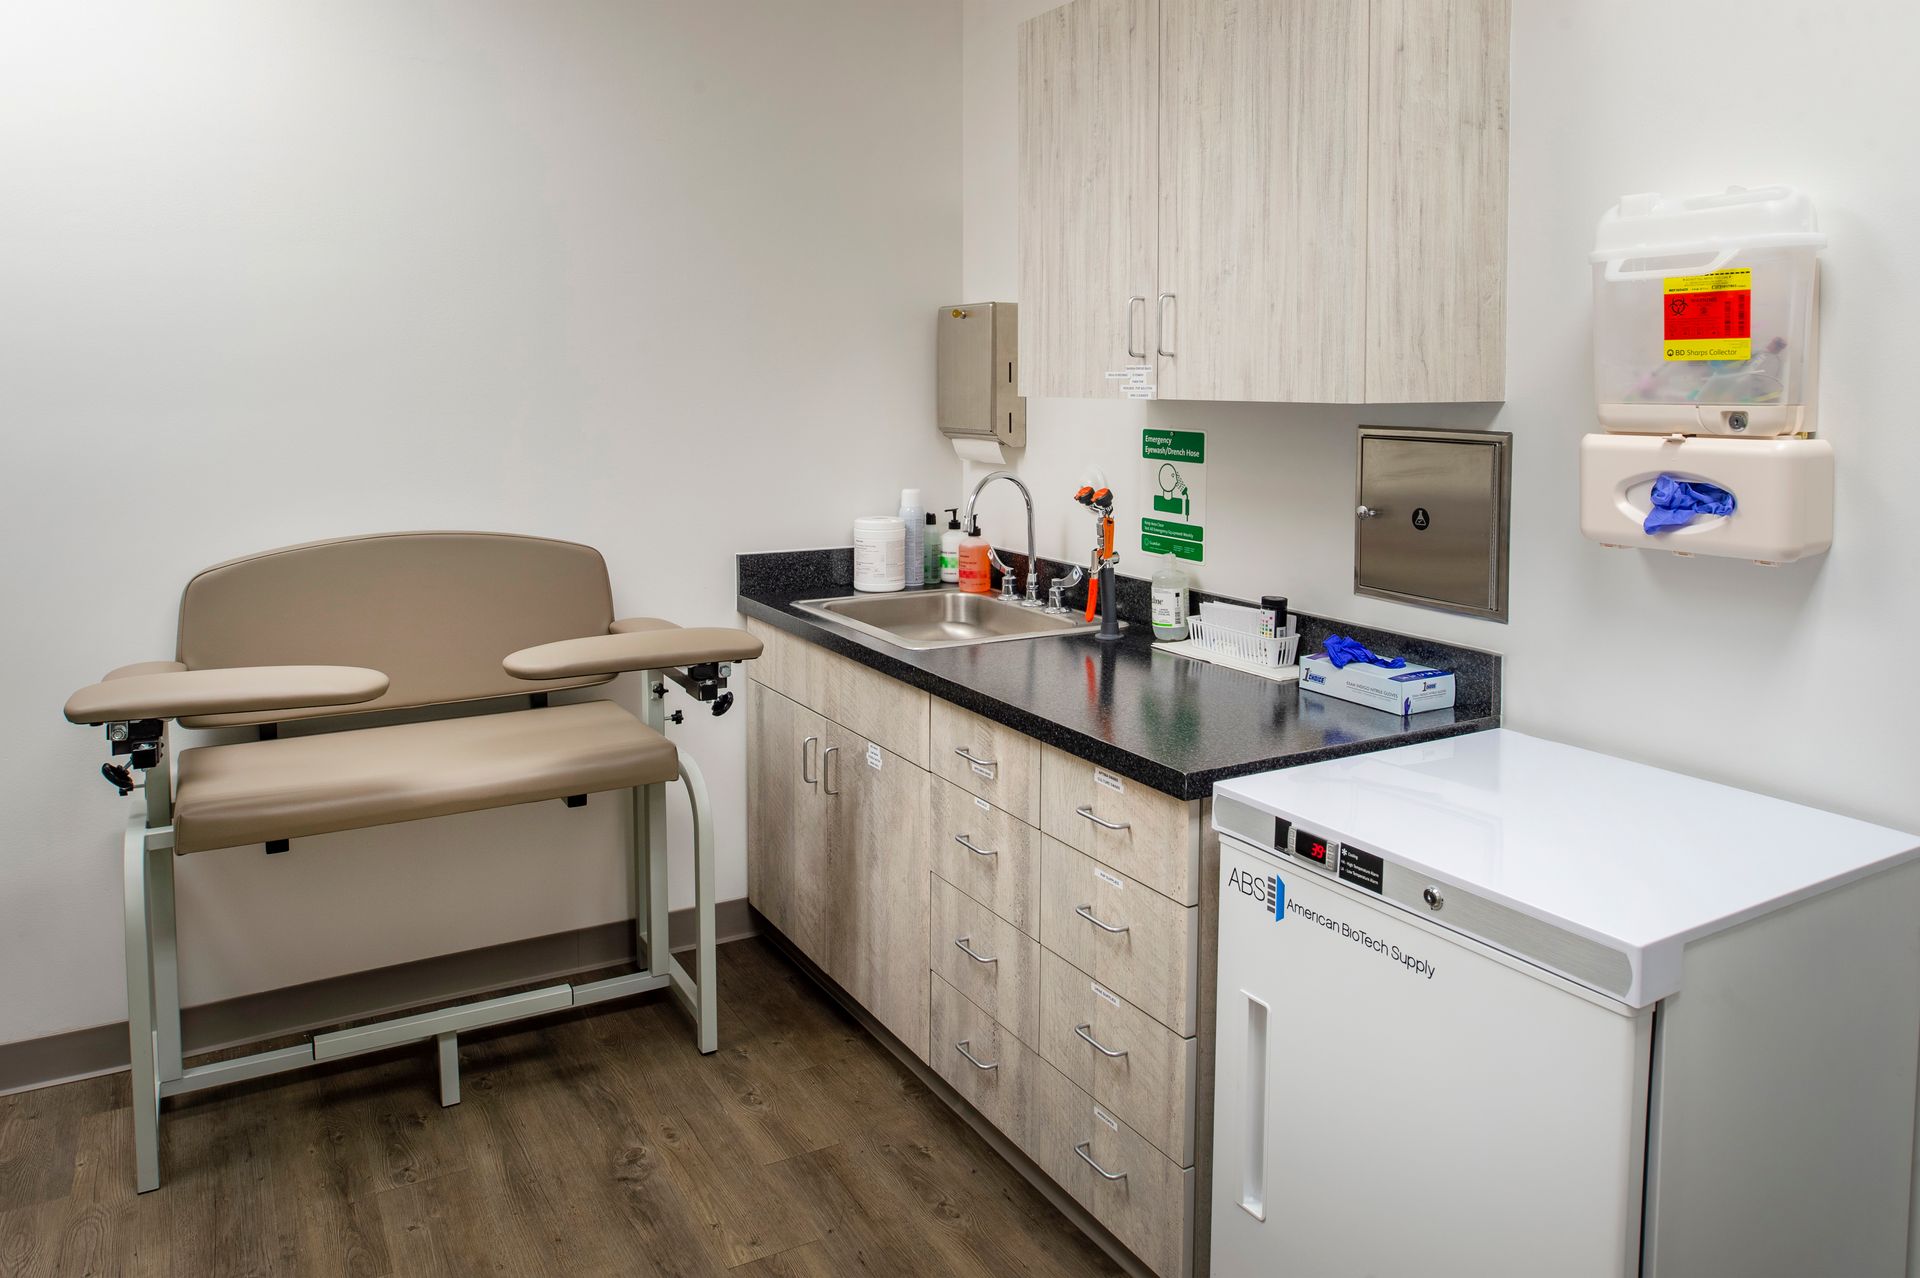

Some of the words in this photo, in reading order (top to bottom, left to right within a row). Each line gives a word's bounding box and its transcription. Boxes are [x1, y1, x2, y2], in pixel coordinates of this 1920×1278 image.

[1145, 435, 1172, 446] Emergency
[1145, 446, 1185, 456] Eyewash/Drench
[1186, 450, 1200, 458] Hose
[1309, 674, 1325, 684] CHOICE
[1384, 690, 1398, 699] GLOVES
[1311, 842, 1324, 858] 39
[1354, 864, 1370, 874] Temperature
[1353, 871, 1369, 881] Temperature
[1228, 867, 1266, 901] ABS
[1286, 898, 1340, 933] American
[1342, 922, 1388, 956] BioTech
[1391, 945, 1436, 980] Supply
